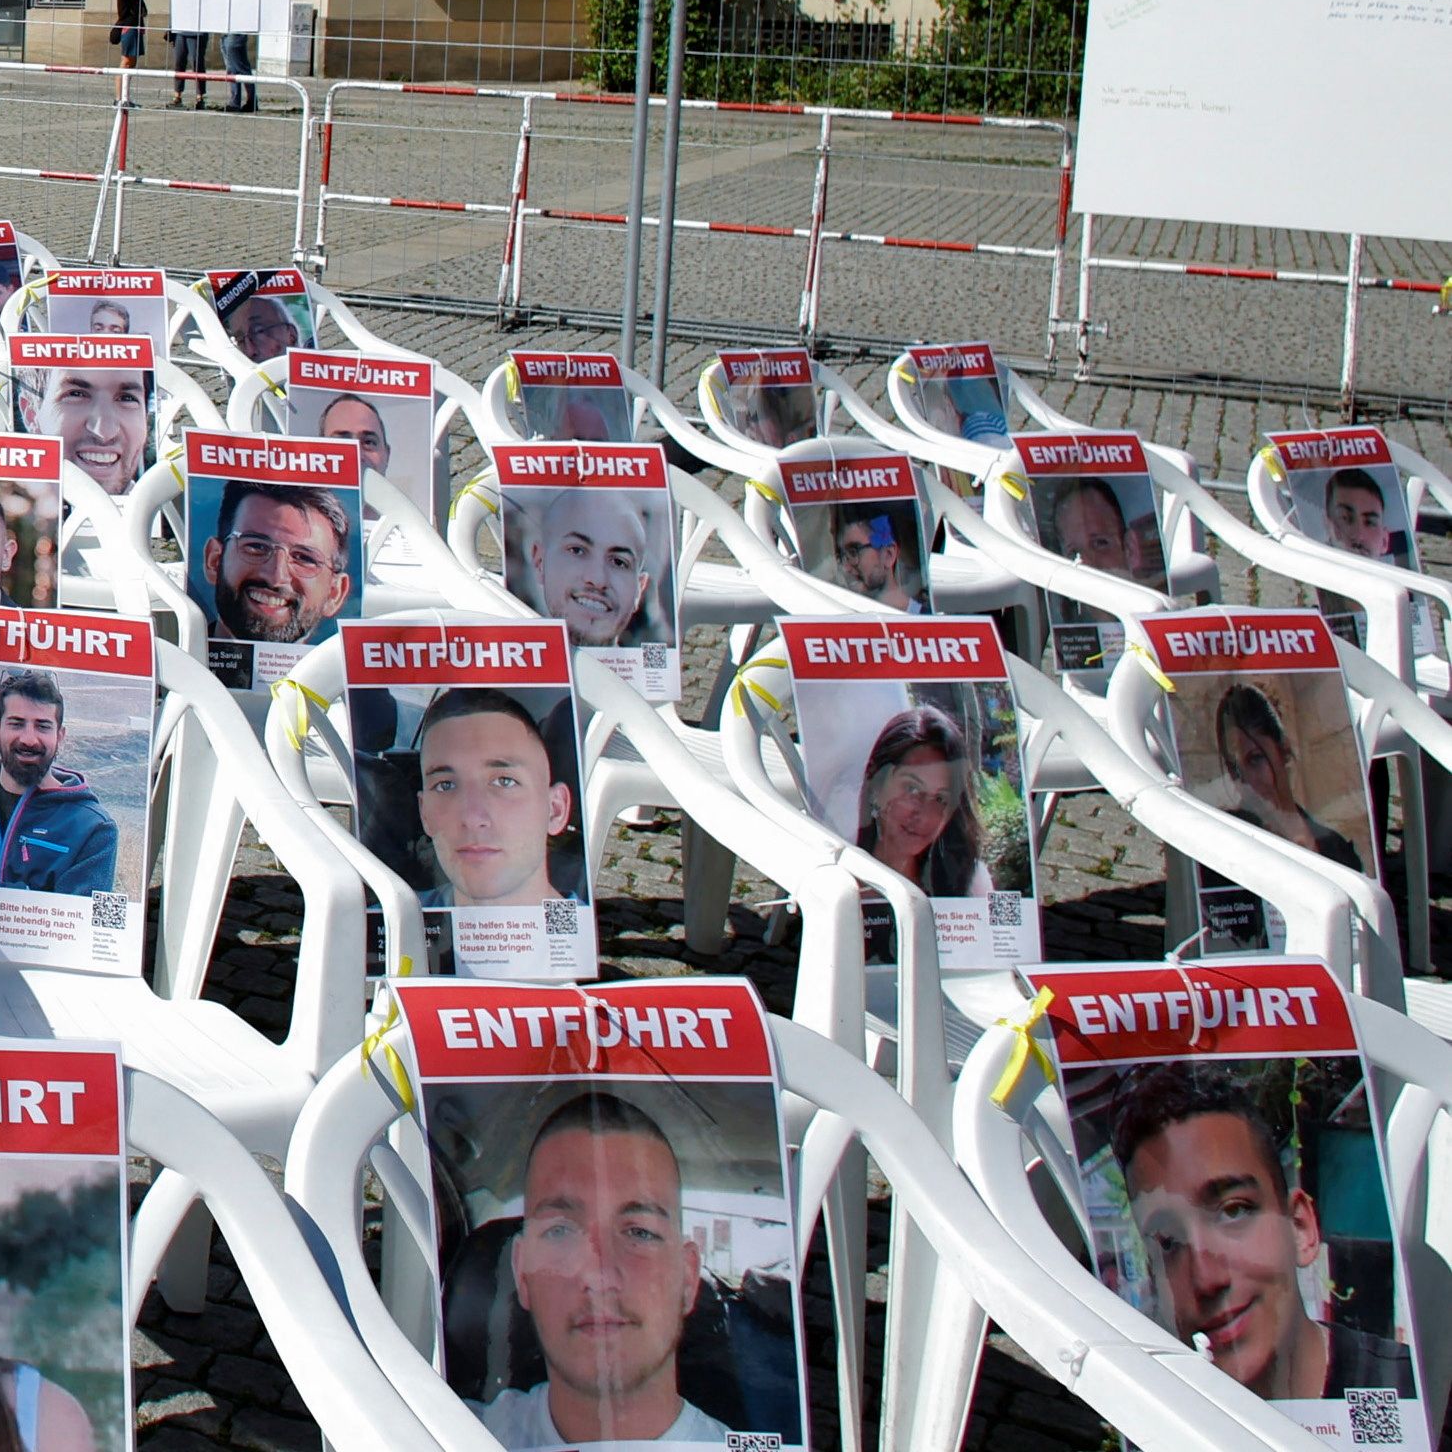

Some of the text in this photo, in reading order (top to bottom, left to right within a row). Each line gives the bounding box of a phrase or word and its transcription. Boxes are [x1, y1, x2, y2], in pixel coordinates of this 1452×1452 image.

[58, 275, 152, 290] ENTFÜHRT
[21, 343, 140, 360] ENTFÜHRT
[301, 362, 419, 386] ENTFÜHRT
[525, 361, 611, 379] ENTFÜHRT
[1030, 444, 1132, 465] ENTFÜHRT
[1288, 437, 1376, 458] ENTFÜHRT
[201, 446, 345, 474] ENTFÜHRT
[511, 455, 649, 476] ENTFÜHRT
[793, 468, 899, 491] ENTFÜHRT
[806, 635, 981, 664] ENTFÜHRT
[1165, 628, 1317, 658] ENTFÜHRT
[362, 640, 547, 668] ENTFÜHRT
[0, 903, 20, 913] Bitte
[22, 905, 49, 915] helfen
[51, 908, 65, 917] Sie
[0, 915, 75, 930] sie lebendig nach
[27, 929, 38, 937] zu
[1073, 986, 1319, 1034] ENTFÜHRT
[437, 1000, 732, 1051] ENTFÜHRT
[1316, 1422, 1341, 1437] mit,
